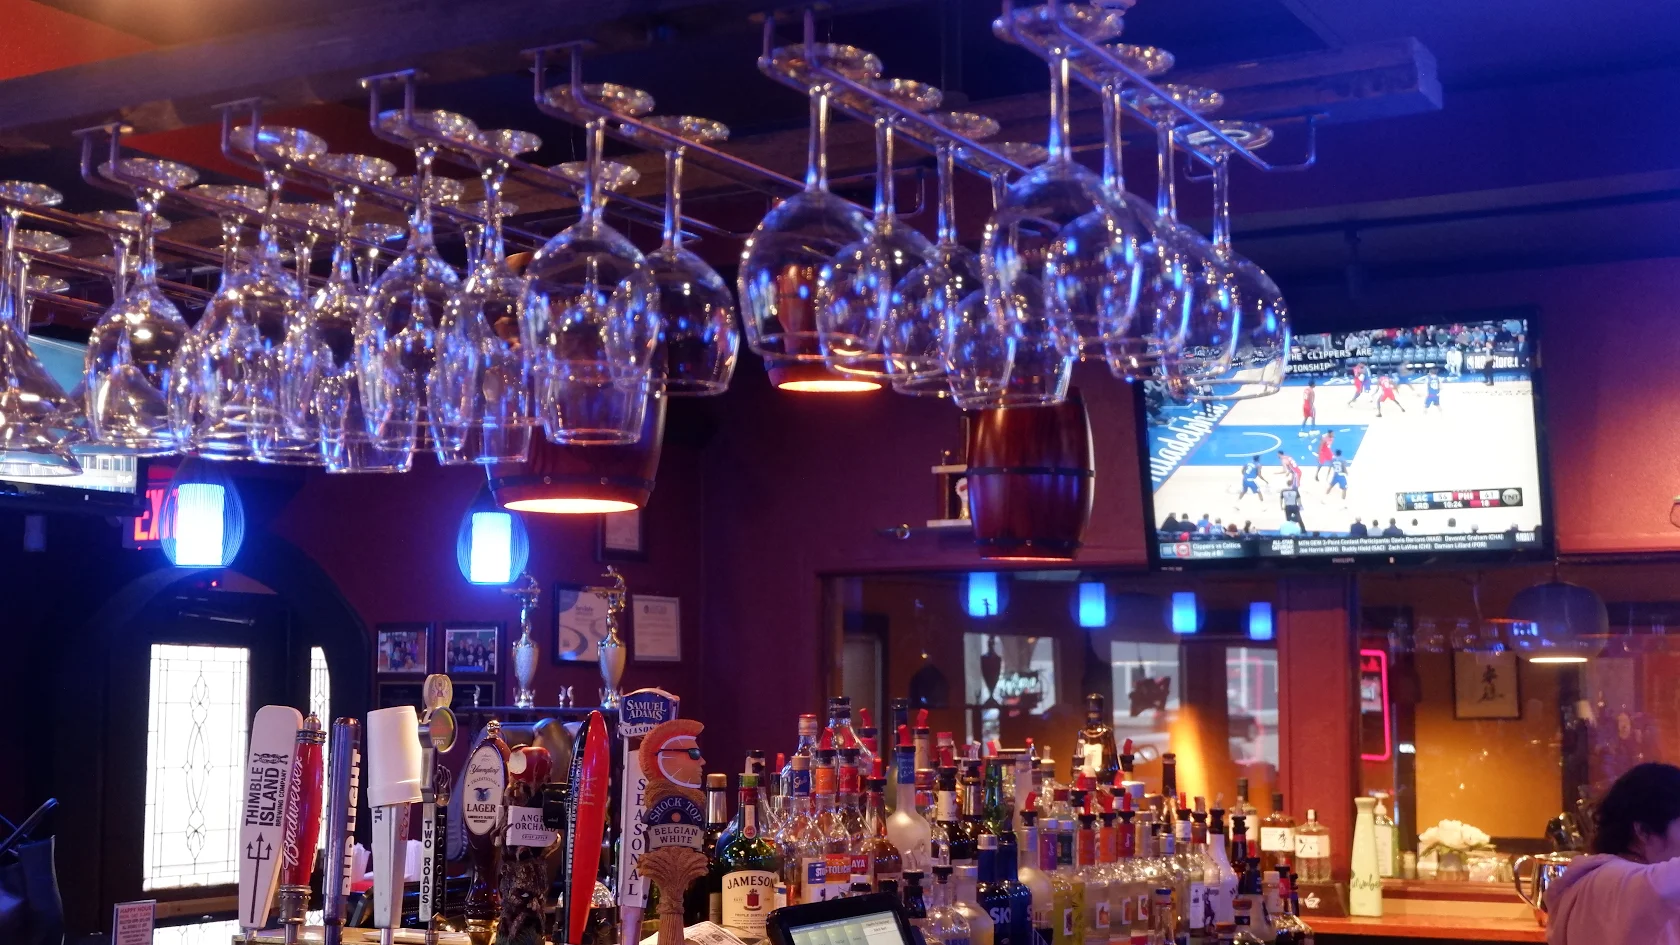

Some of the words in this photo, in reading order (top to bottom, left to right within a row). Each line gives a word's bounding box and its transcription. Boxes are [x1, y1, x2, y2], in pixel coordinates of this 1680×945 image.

[1307, 349, 1351, 360] CLIPPERS
[1356, 348, 1372, 357] ARE
[1458, 492, 1474, 500] PHI
[1413, 502, 1429, 510] 3RD
[626, 699, 667, 713] SAMUEL
[628, 709, 664, 721] ADAMS
[624, 727, 653, 735] SEASON
[279, 769, 288, 798] COMPANY
[347, 748, 361, 832] LIGHT
[246, 766, 264, 826] THIMBLE
[259, 767, 279, 827] ISLAND
[276, 799, 284, 827] BREWING
[283, 756, 303, 870] Budweiser
[466, 803, 497, 813] LAGER
[651, 797, 682, 823] SHOCK
[686, 800, 703, 823] TOP
[520, 814, 544, 823] ANGR
[424, 820, 433, 848] TWO
[628, 779, 646, 896] SEASONAL
[654, 826, 699, 836] BELGIAN
[659, 835, 693, 845] WHITE
[422, 857, 431, 904] ROADS
[727, 875, 774, 890] JAMESON
